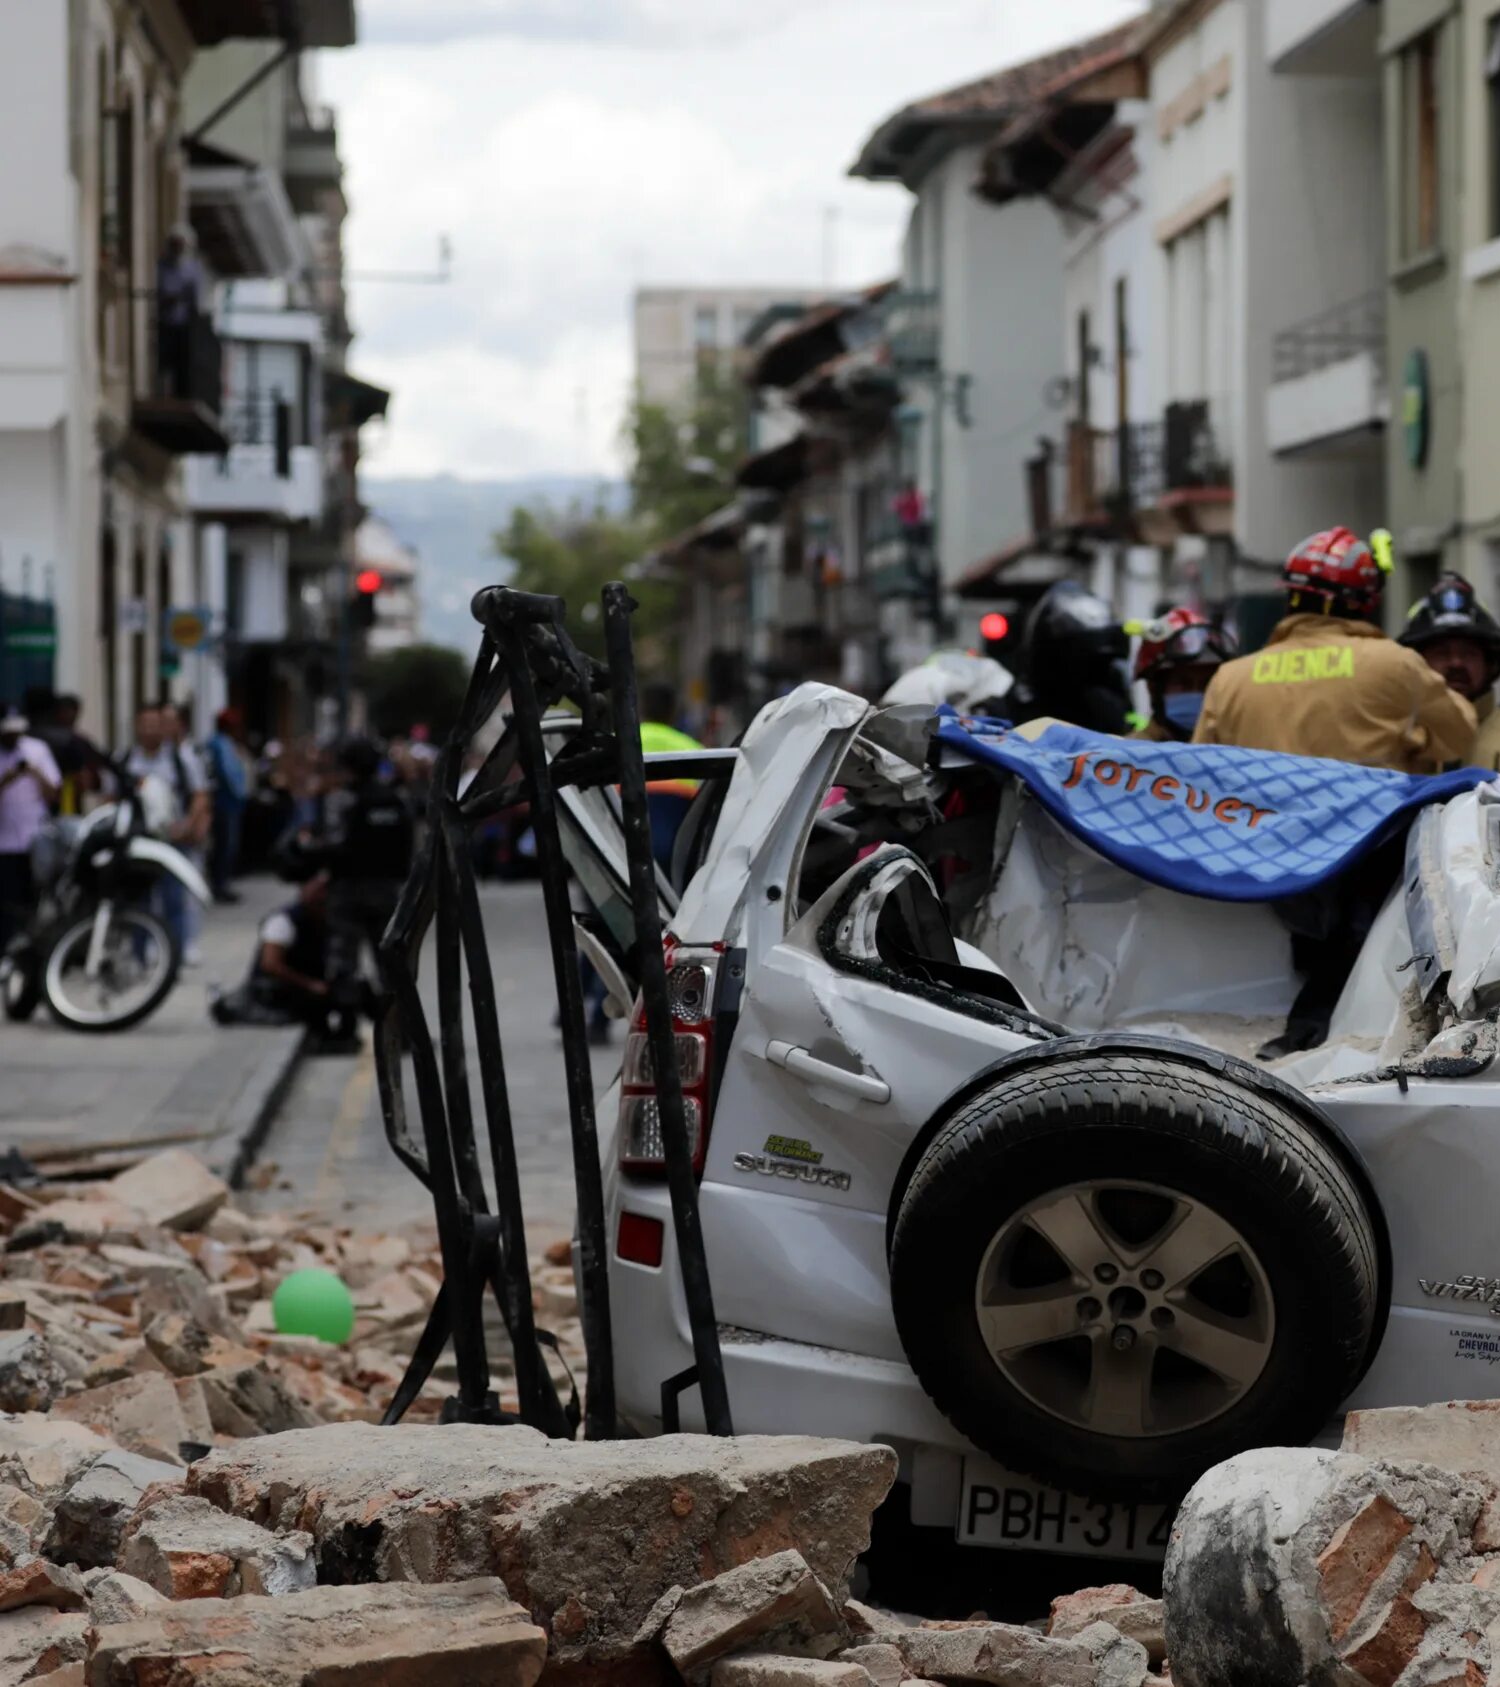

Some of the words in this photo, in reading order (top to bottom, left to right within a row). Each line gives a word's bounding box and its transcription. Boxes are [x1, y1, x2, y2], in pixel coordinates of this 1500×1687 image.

[1252, 644, 1354, 684] CUENCA
[1062, 751, 1280, 829] forever
[733, 1151, 851, 1191] SUZUKI
[1461, 1331, 1483, 1340] GRAN
